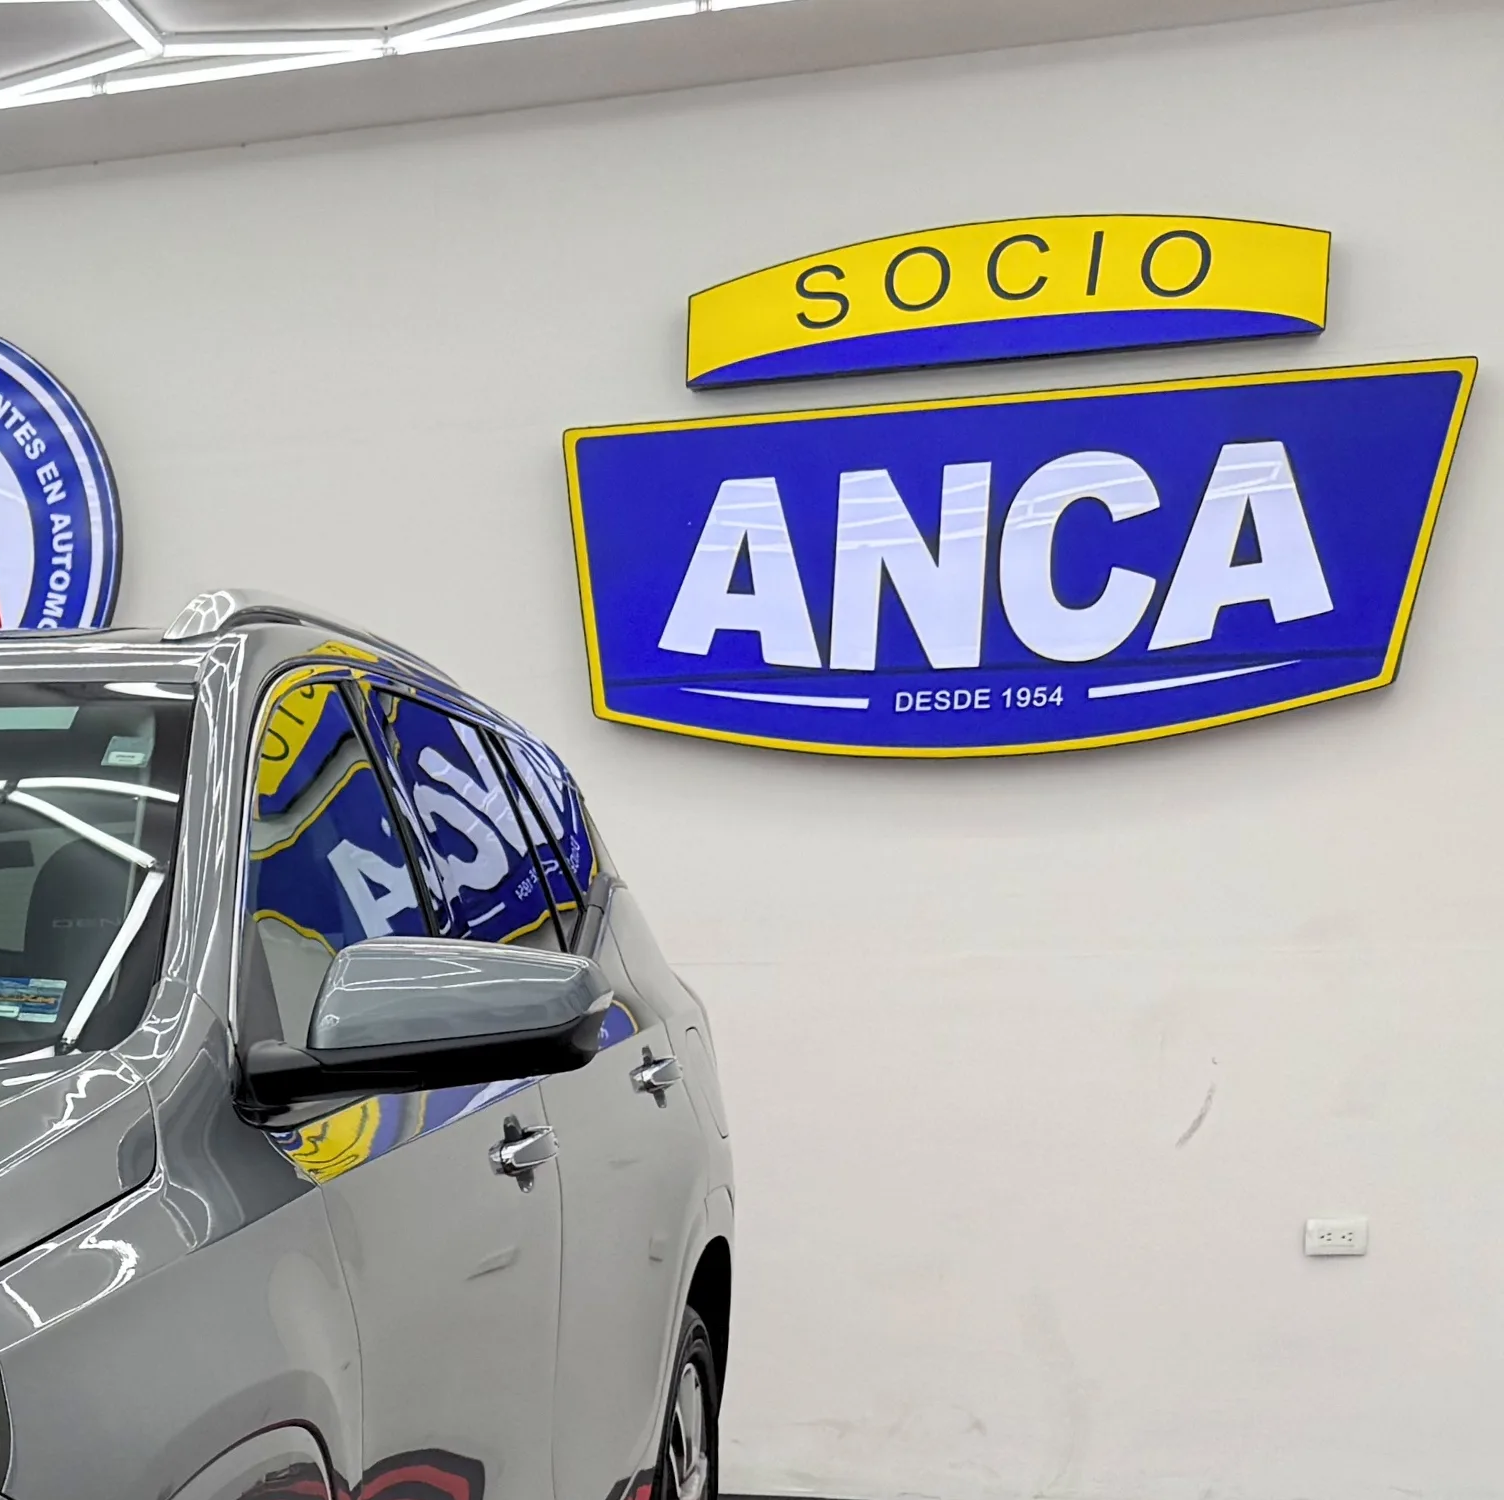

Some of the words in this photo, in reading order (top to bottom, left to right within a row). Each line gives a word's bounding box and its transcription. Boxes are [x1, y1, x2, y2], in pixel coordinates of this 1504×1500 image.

[794, 229, 1213, 330] SOCIO
[36, 460, 67, 505] EN
[657, 440, 1335, 671] ANCA
[894, 687, 993, 713] DESDE
[1001, 685, 1065, 710] 1954
